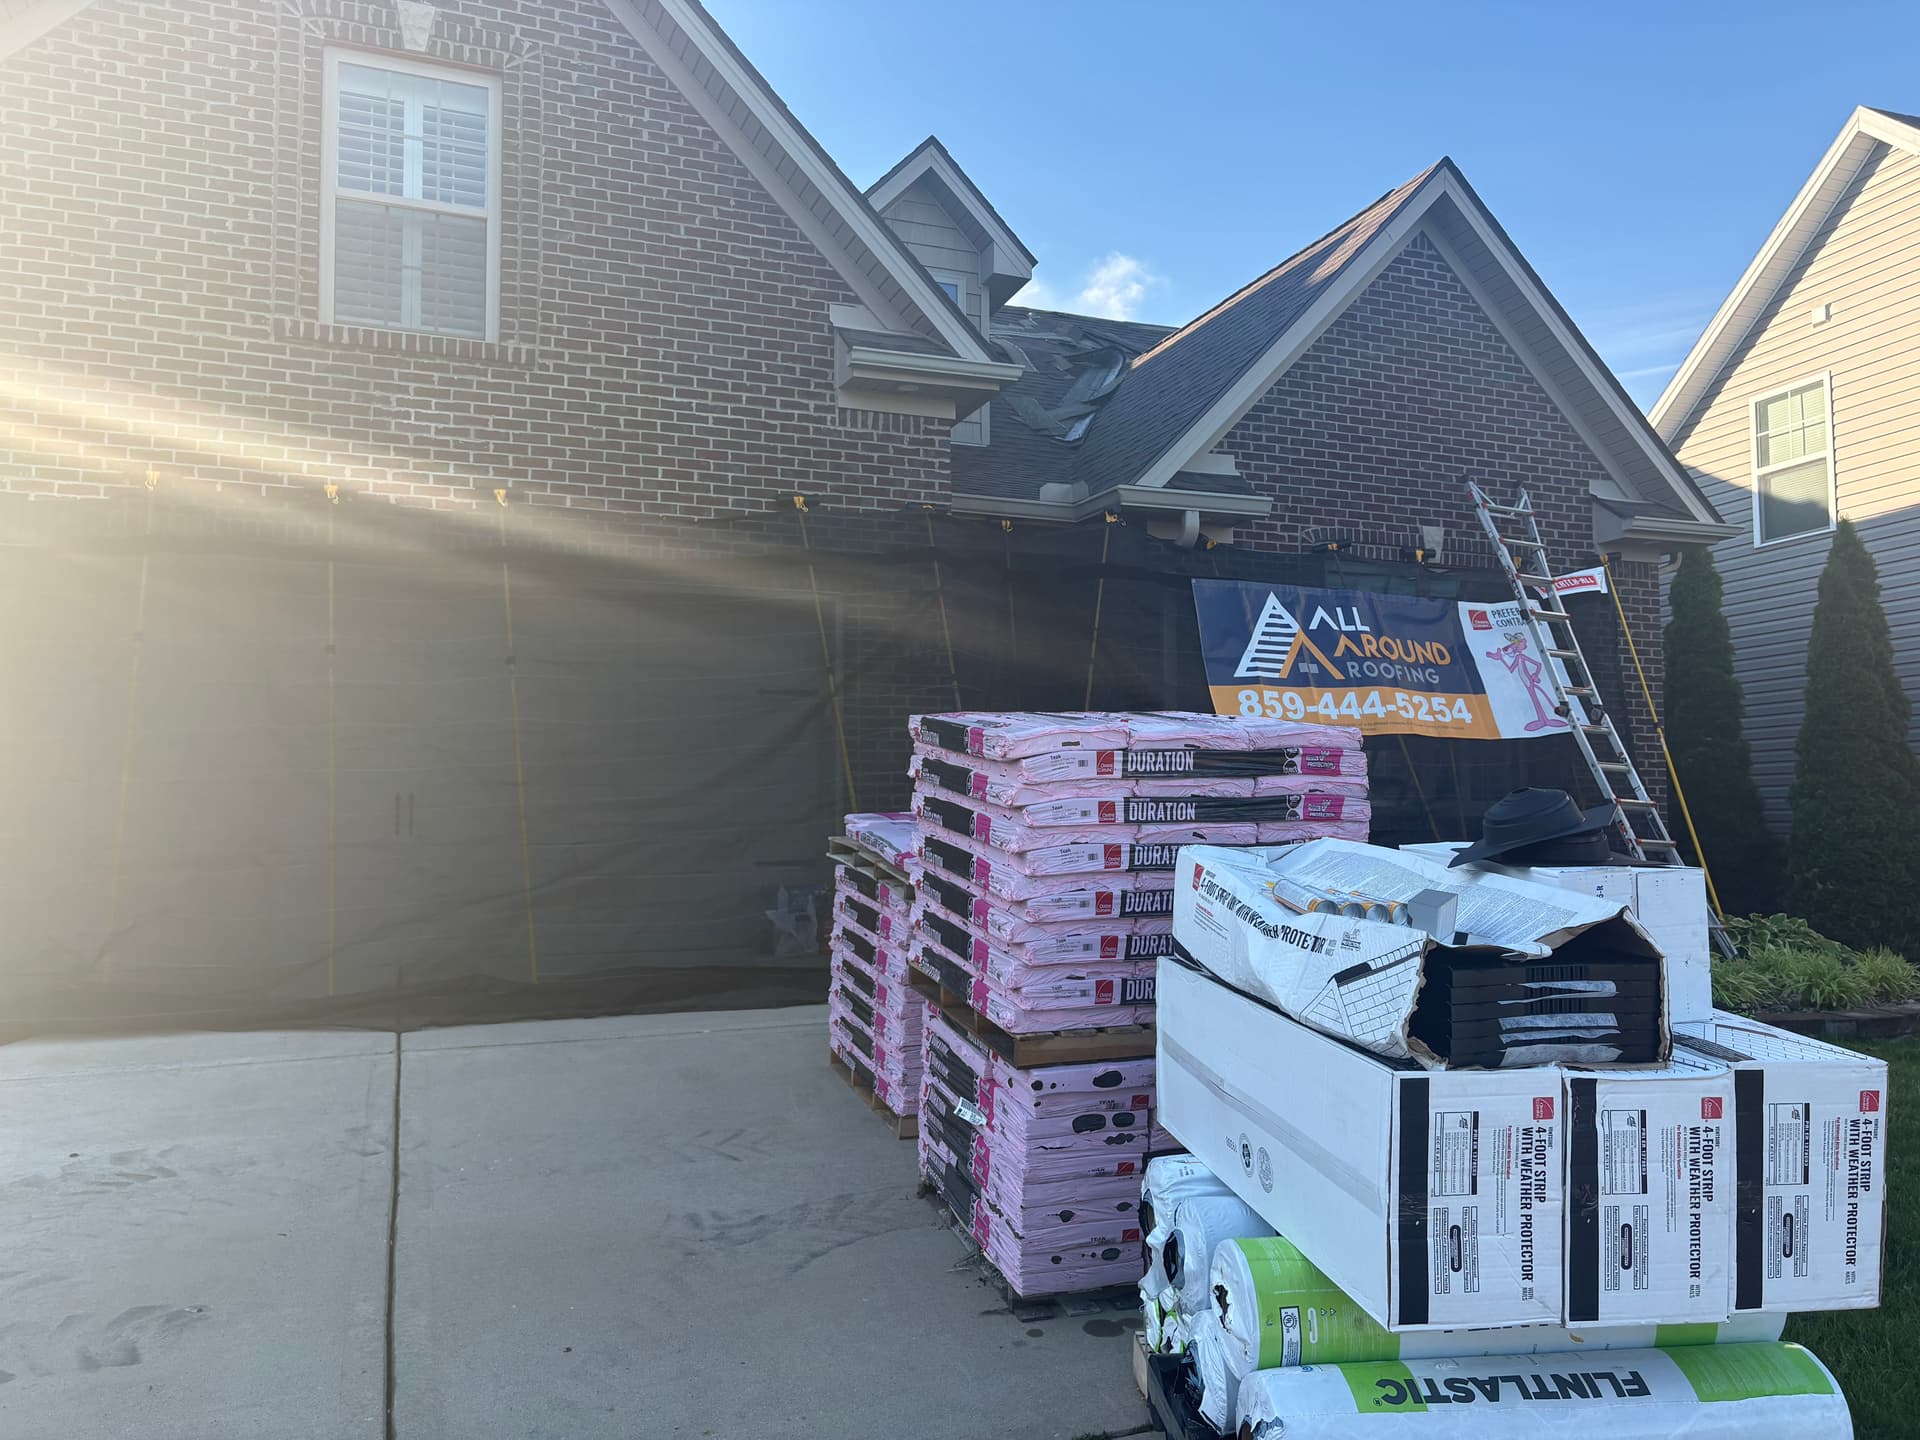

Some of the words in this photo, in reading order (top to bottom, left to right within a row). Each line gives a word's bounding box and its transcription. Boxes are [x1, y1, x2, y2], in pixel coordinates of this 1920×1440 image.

[1308, 605, 1370, 632] ALL
[1491, 607, 1522, 619] PREFER
[1334, 634, 1452, 665] AROUND
[1346, 661, 1440, 684] ROOFING
[1238, 689, 1472, 724] 859-444-5254
[1128, 751, 1194, 772] DURATION
[1129, 802, 1196, 821] DURATION
[1134, 845, 1176, 865] DURAT
[1126, 891, 1172, 912] DURATI
[1131, 936, 1172, 955] DURAT
[1280, 925, 1328, 954] PROTETOR
[1521, 1127, 1532, 1154] WITH
[1534, 1127, 1546, 1168] 4-FOOT
[1689, 1127, 1700, 1153] WITH
[1702, 1126, 1713, 1167] 4-FOOT
[1849, 1119, 1860, 1145] WITH
[1860, 1119, 1872, 1158] 4-FOOT
[1520, 1158, 1533, 1210] WEATHER
[1534, 1171, 1546, 1203] STRIP
[1689, 1158, 1700, 1209] WEATHER
[1702, 1170, 1714, 1202] STRIP
[1847, 1150, 1859, 1198] WEATHER
[1860, 1161, 1872, 1192] STRIP
[1520, 1214, 1533, 1281] PROTECTOR
[1689, 1214, 1701, 1278] PROTECTOR
[1846, 1203, 1857, 1265] PROTECTOR
[1376, 1371, 1650, 1406] FLINTLASTIC
